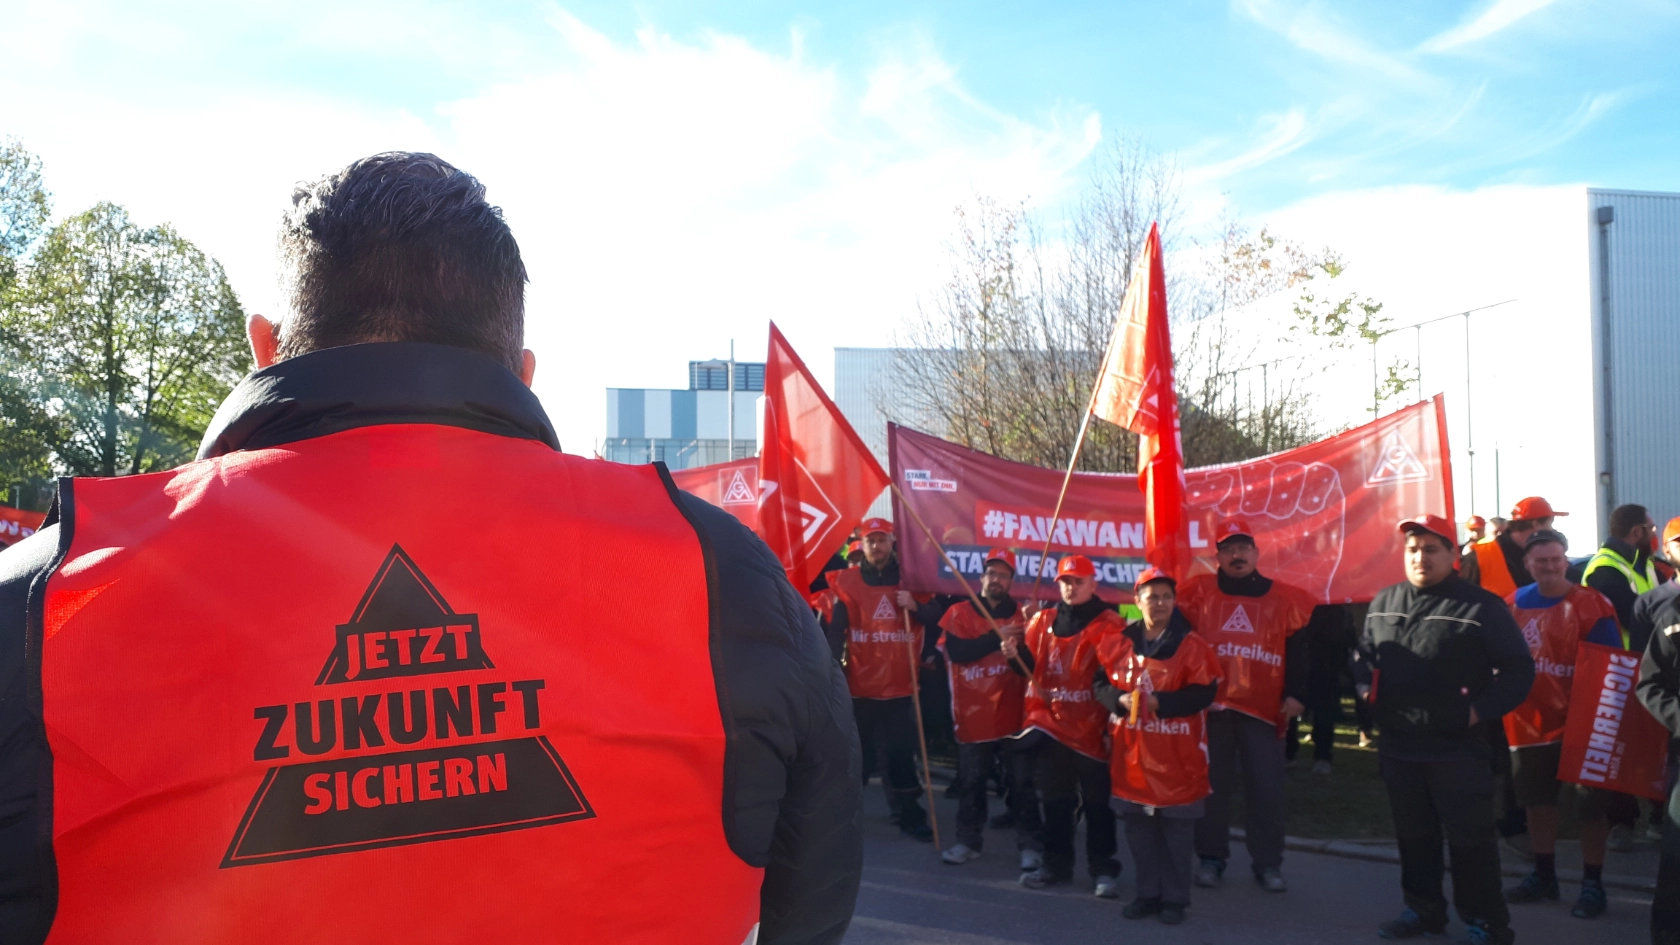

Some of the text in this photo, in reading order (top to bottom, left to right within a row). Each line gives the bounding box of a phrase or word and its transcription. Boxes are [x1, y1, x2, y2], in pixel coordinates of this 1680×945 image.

[983, 509, 1208, 549] #FAIRWANL
[345, 624, 473, 680] JETZT
[1217, 642, 1282, 666] streiken
[253, 679, 545, 761] ZUKUNFT
[304, 753, 508, 815] SICHERN
